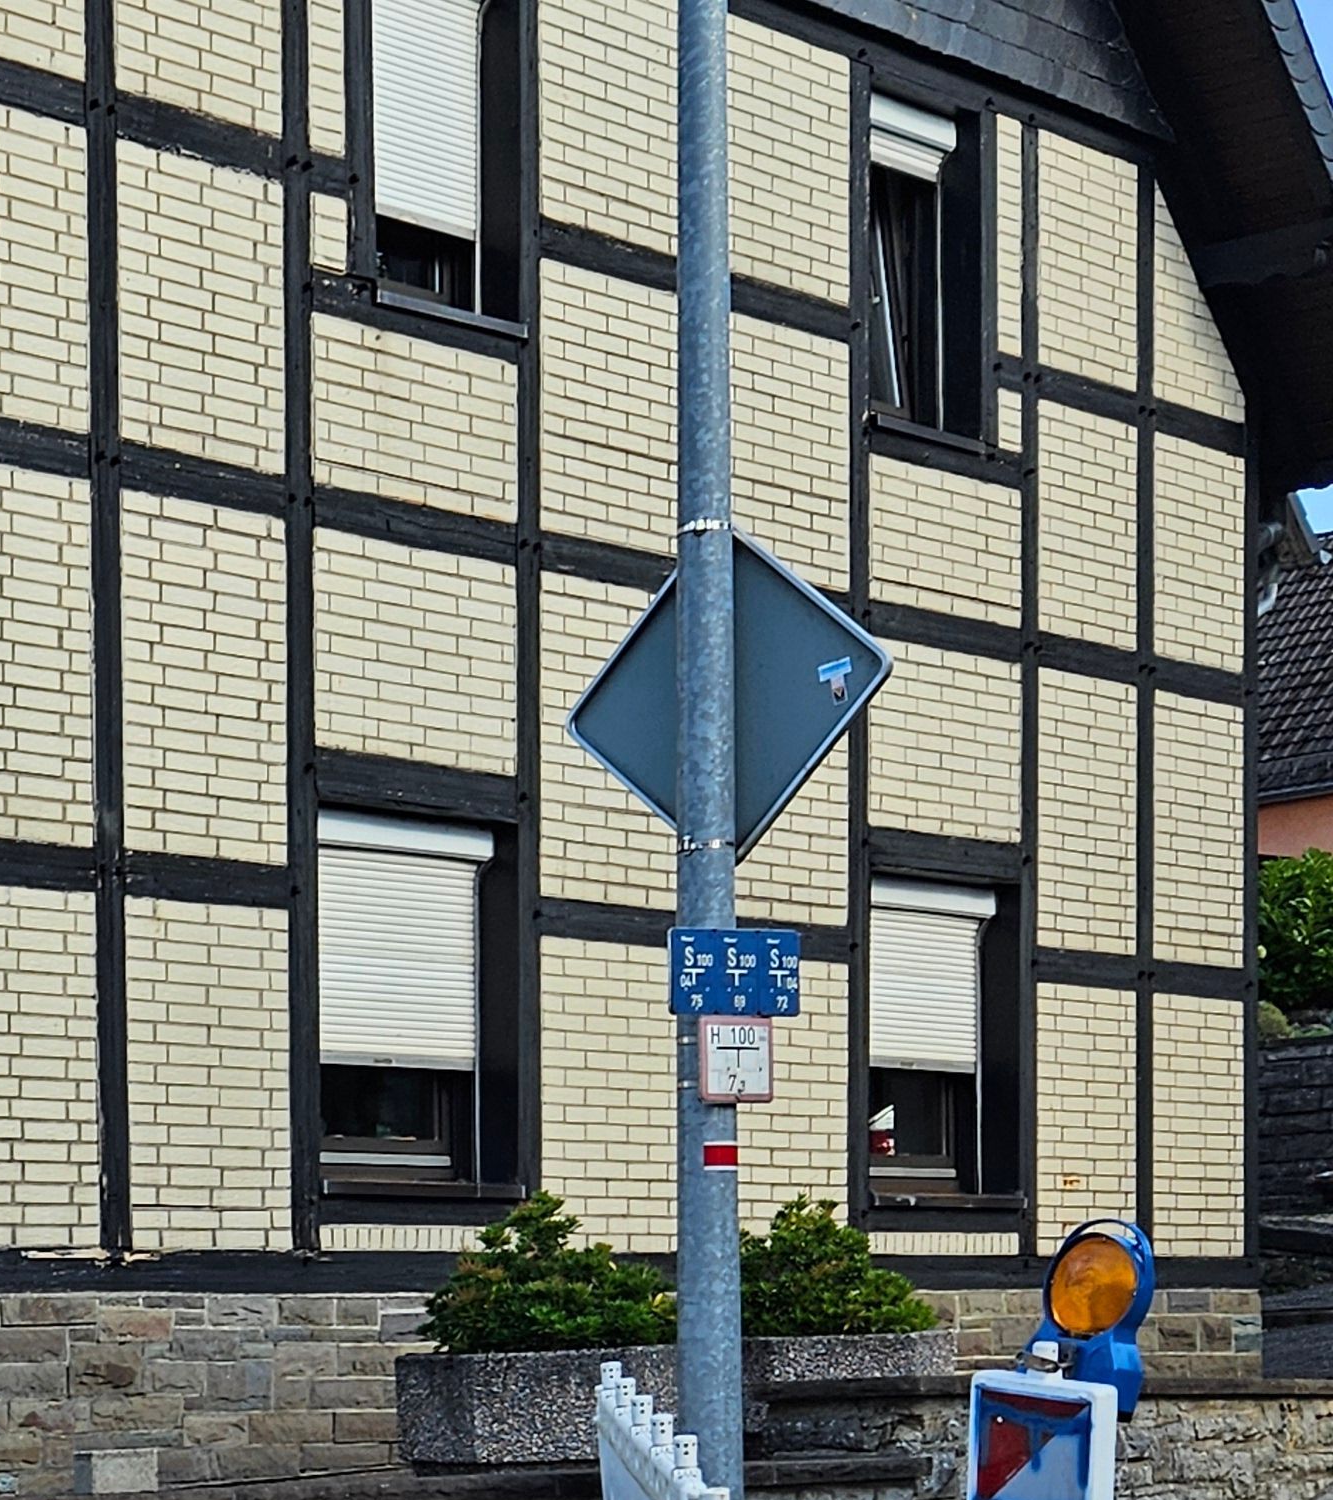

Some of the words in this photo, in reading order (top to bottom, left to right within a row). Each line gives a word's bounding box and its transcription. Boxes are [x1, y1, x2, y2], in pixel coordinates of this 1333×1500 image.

[684, 946, 694, 967] S
[696, 953, 713, 967] 100
[727, 947, 737, 968] S
[739, 954, 757, 968] 100
[770, 948, 780, 968] S
[782, 955, 798, 970] 100
[710, 1026, 721, 1045] H
[731, 1026, 756, 1046] 100
